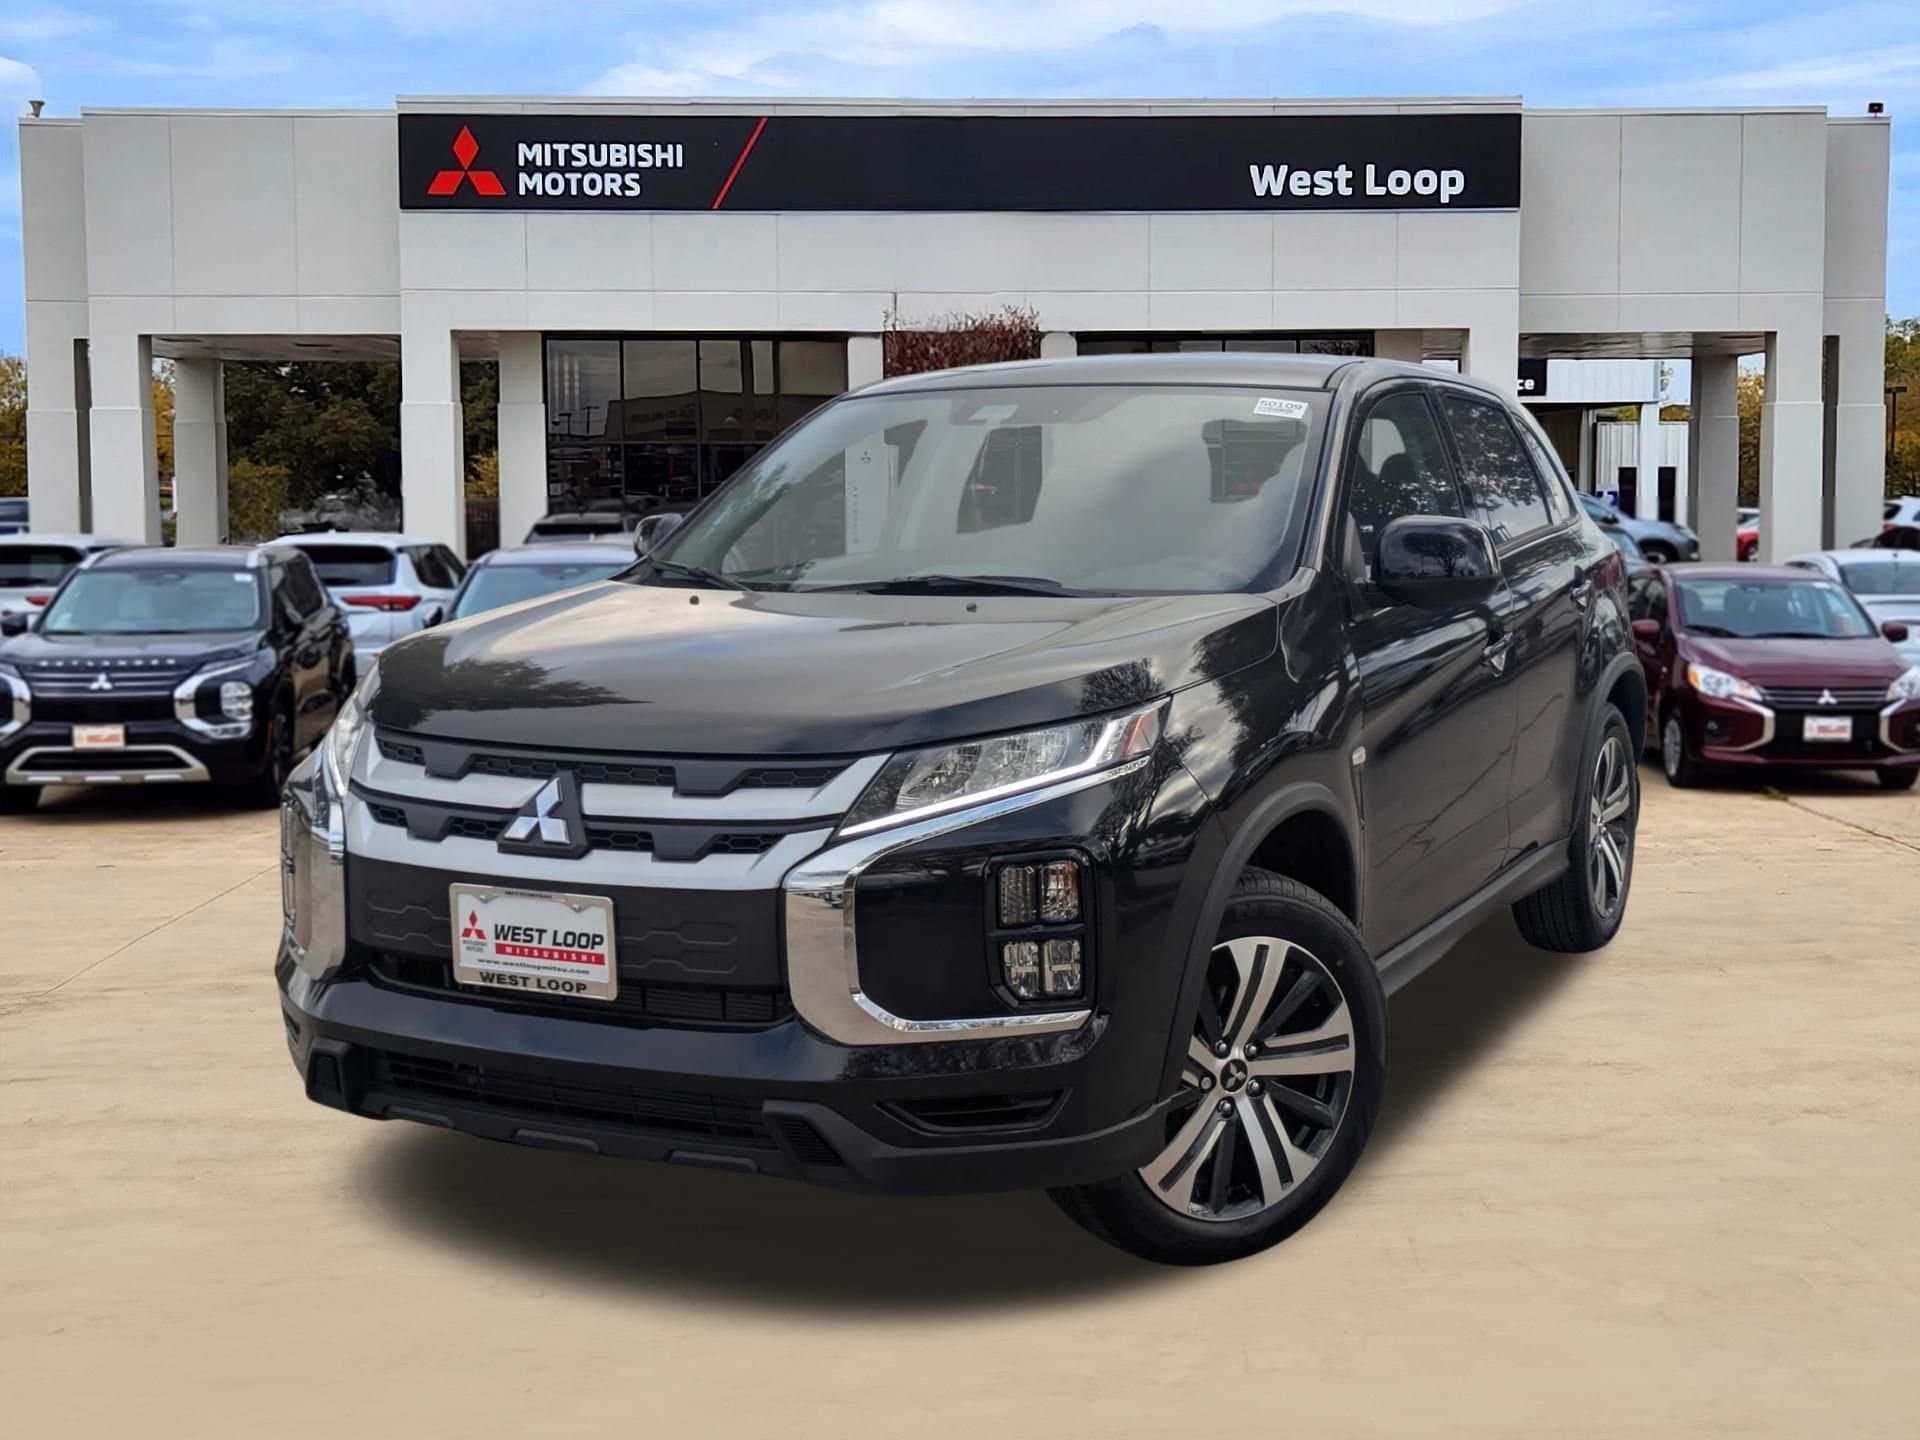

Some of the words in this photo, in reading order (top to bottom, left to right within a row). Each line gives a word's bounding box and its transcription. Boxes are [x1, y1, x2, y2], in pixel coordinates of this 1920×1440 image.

[518, 143, 683, 168] MITSUBISHI
[518, 172, 641, 197] MOTORS
[1249, 164, 1353, 196] West
[1365, 164, 1465, 203] Loop
[494, 924, 548, 945] WEST
[552, 930, 604, 950] LOOP
[505, 945, 596, 962] MITSUBISHI
[480, 971, 530, 987] WEST
[537, 978, 588, 993] LOOP
